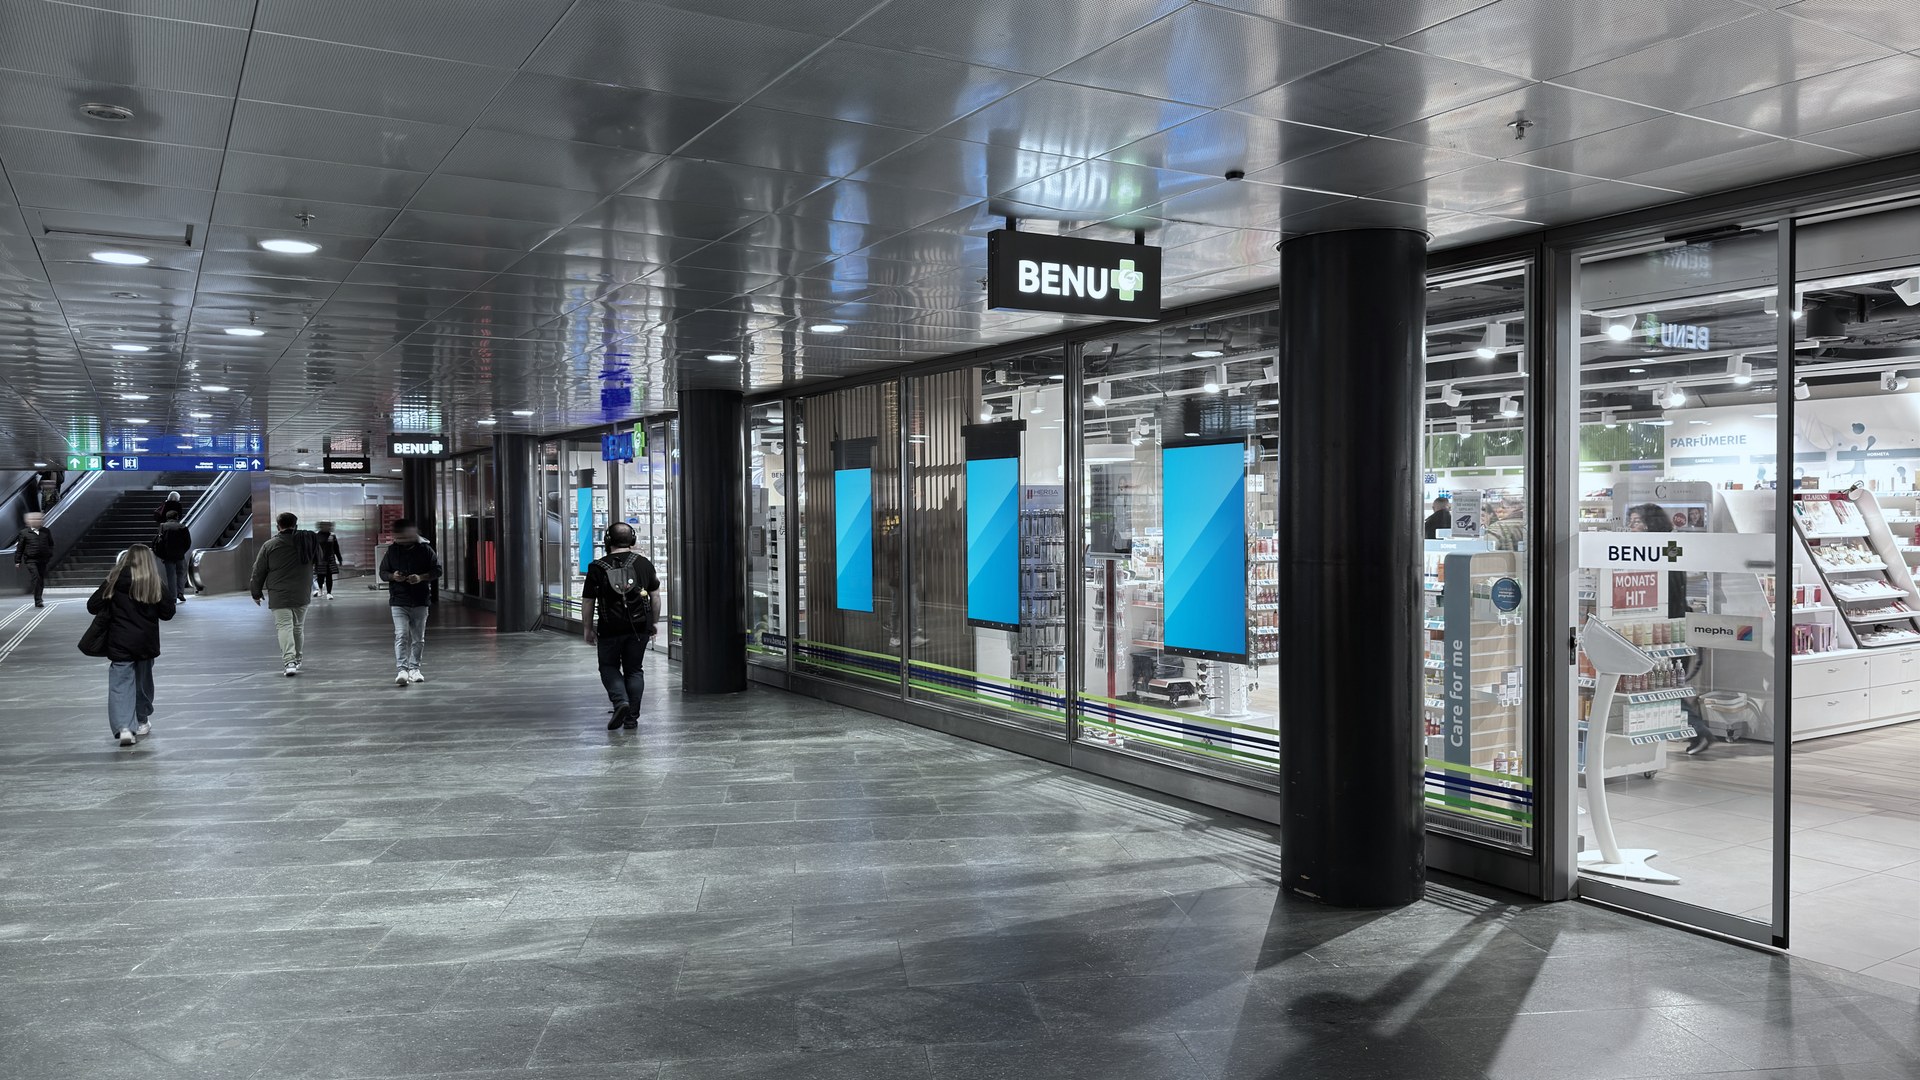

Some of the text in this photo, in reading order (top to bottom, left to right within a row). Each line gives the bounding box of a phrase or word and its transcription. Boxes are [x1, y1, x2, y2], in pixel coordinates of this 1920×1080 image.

[1018, 259, 1109, 299] BENU
[393, 442, 430, 454] BENU
[1670, 433, 1747, 448] PARFÜMERIE
[331, 461, 364, 470] MIGROS
[1608, 545, 1661, 562] BENU
[1615, 574, 1656, 588] MONATS
[1625, 590, 1646, 606] HIT
[1694, 625, 1734, 636] mepha
[1449, 639, 1463, 747] Care for me
